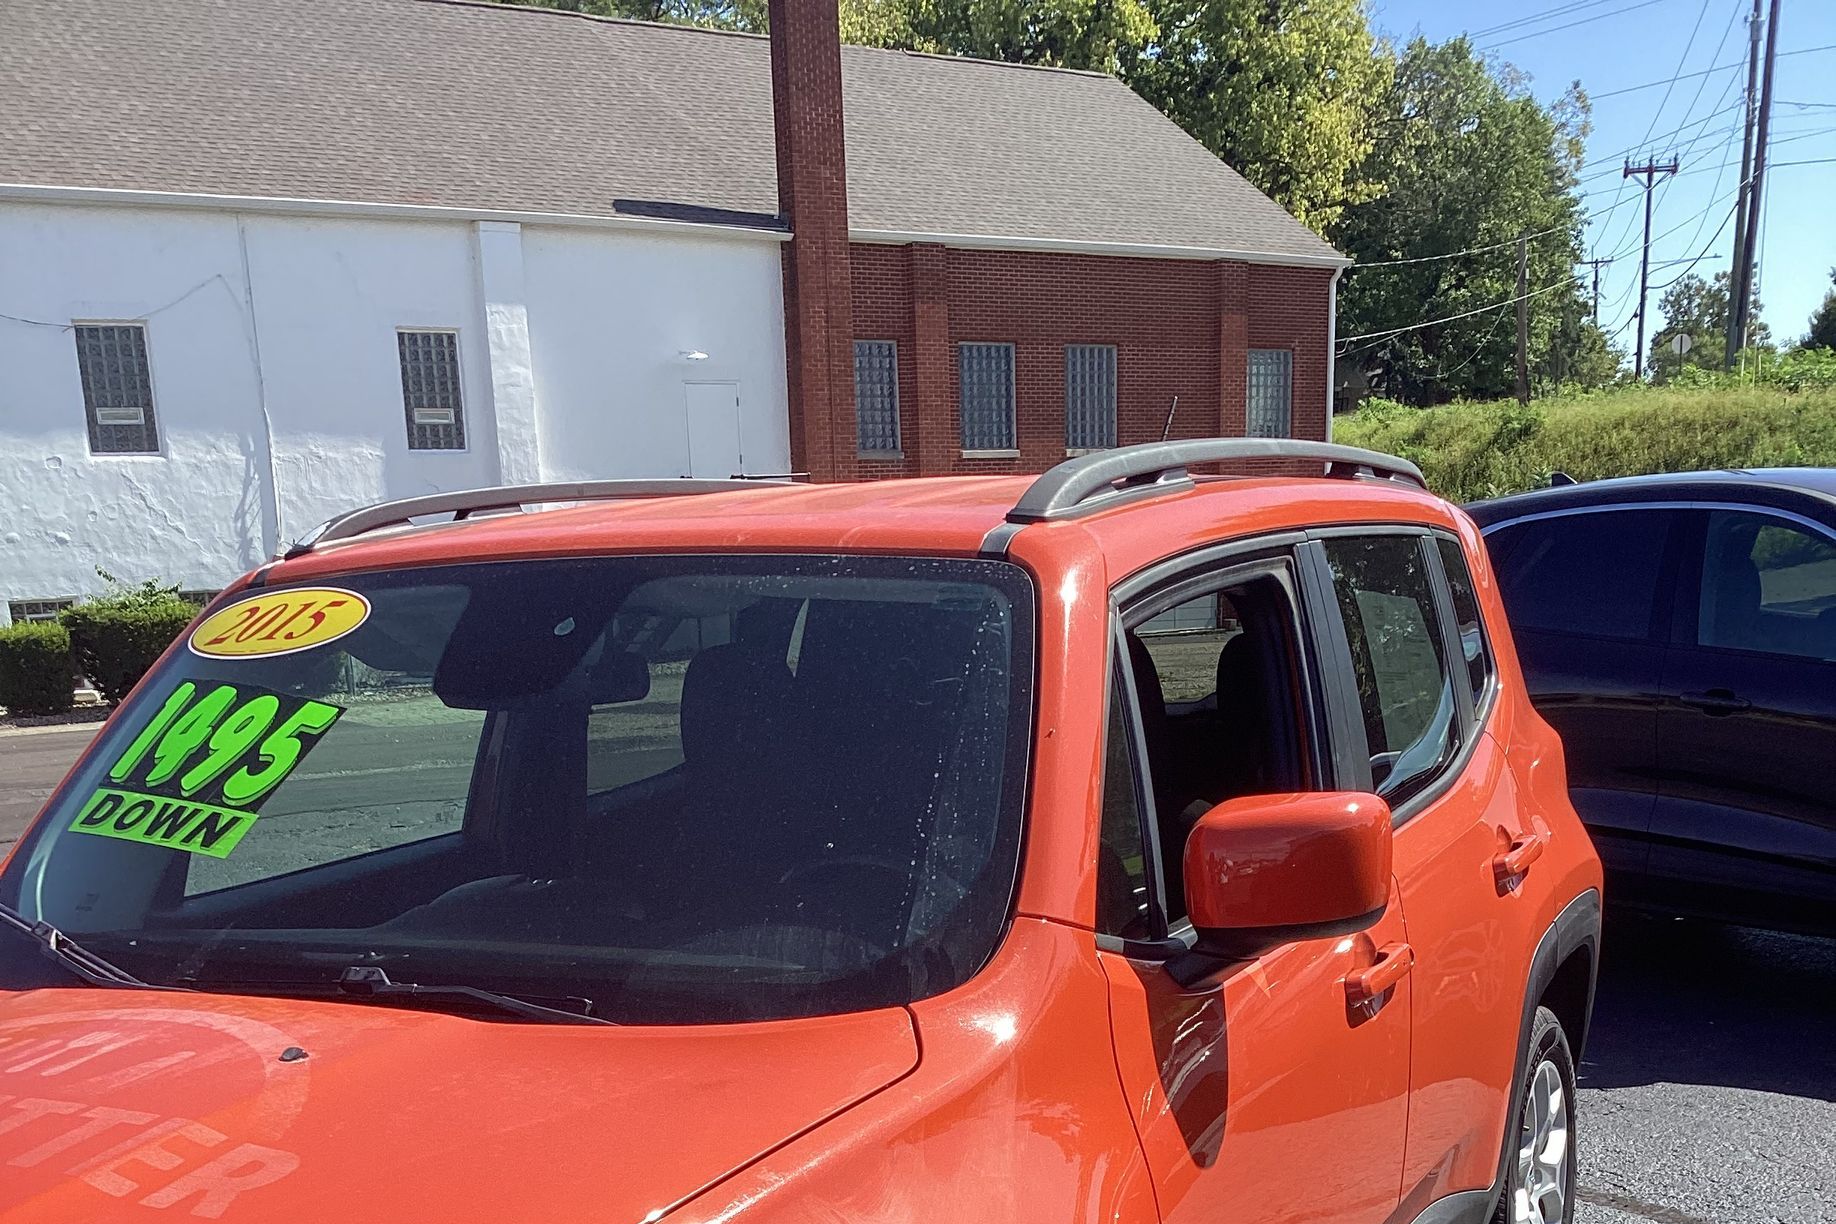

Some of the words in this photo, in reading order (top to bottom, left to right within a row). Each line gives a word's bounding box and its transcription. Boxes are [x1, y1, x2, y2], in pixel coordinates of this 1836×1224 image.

[204, 600, 348, 646] 2015
[110, 682, 340, 804] 1495
[80, 795, 242, 849] DOWN
[0, 1095, 300, 1218] TTER
